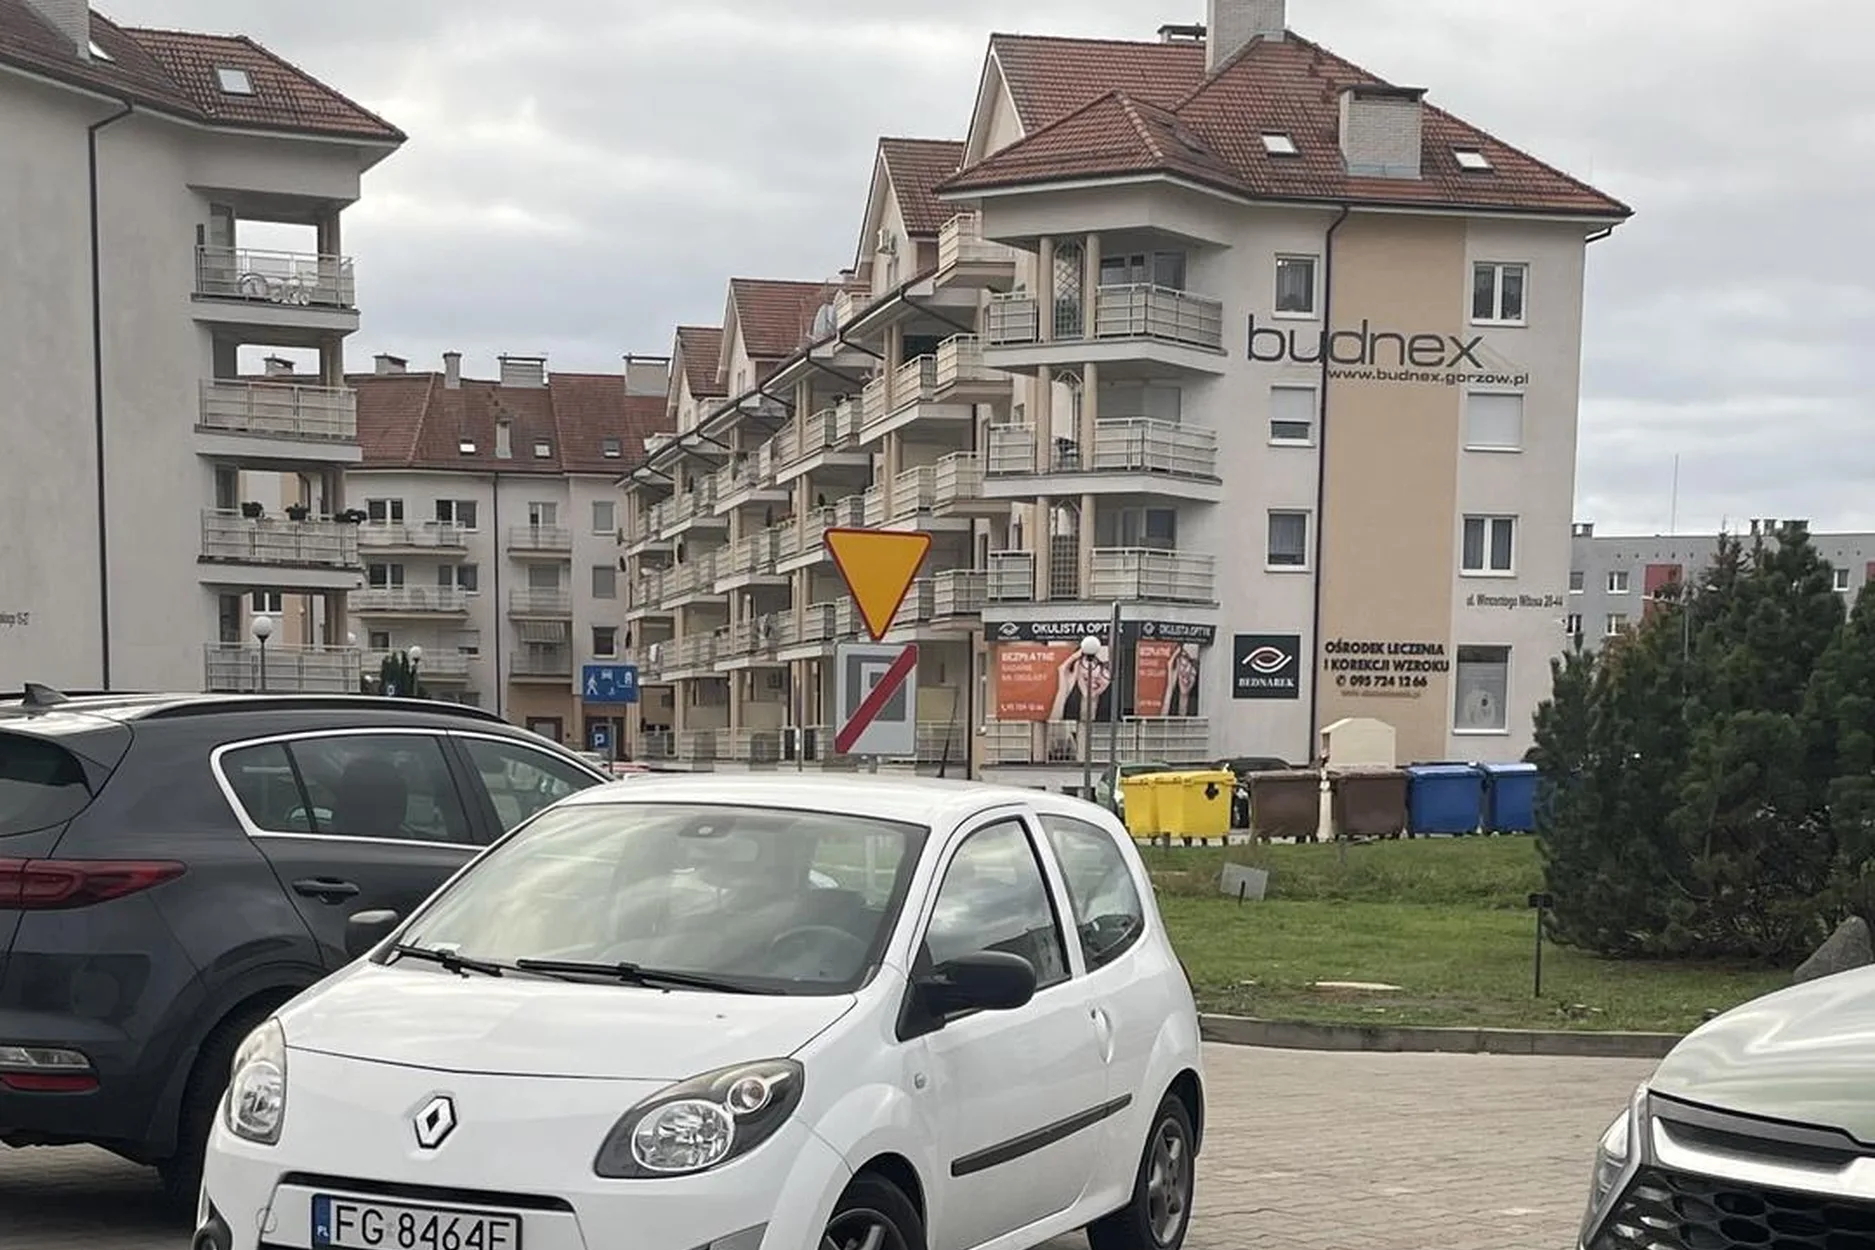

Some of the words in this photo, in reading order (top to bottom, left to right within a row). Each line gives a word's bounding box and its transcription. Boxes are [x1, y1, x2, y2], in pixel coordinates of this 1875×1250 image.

[1247, 314, 1484, 369] budnex
[1327, 367, 1530, 386] www.budnex.gorzow.pl
[1031, 622, 1085, 635] OKULISTA
[1325, 637, 1385, 655] OŚRODEK
[1387, 643, 1445, 656] LECZENIA
[1331, 658, 1390, 672] KOREKCJI
[1392, 659, 1450, 673] WZROKU
[1238, 677, 1295, 688] BEDNAREK
[316, 1225, 330, 1237] PL
[336, 1205, 384, 1245] FG
